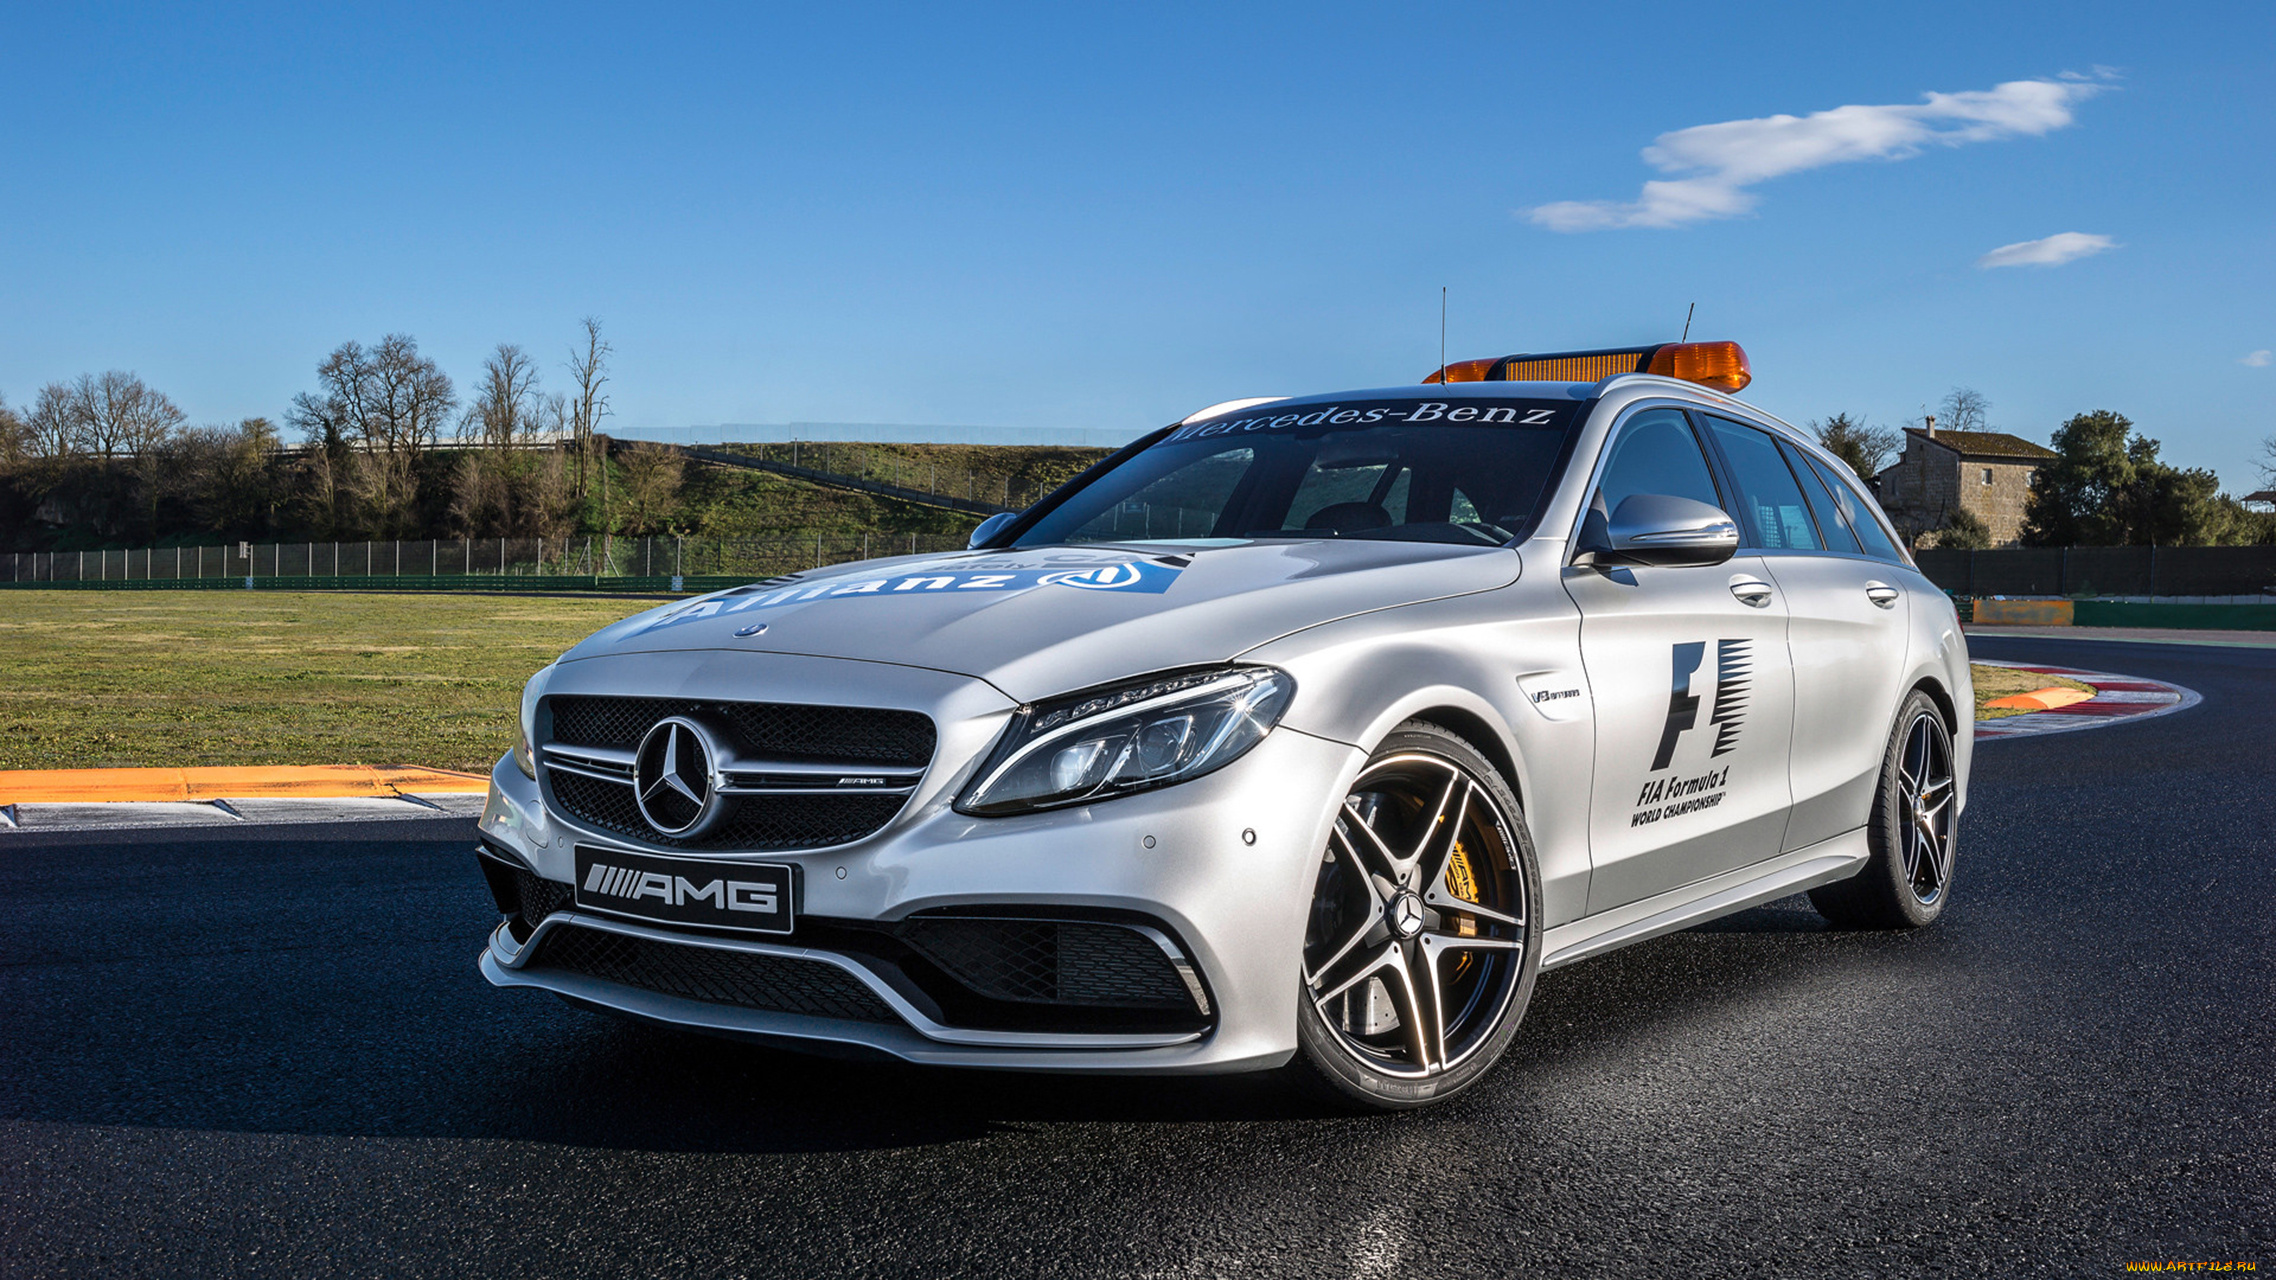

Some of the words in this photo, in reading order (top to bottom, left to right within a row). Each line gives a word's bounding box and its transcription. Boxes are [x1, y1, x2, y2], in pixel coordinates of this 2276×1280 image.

[1161, 402, 1557, 442] Mercedes-Benz
[652, 573, 1017, 628] Allianz
[852, 777, 884, 785] AMG
[1636, 779, 1665, 807] FIA
[1664, 769, 1719, 801] Formula
[1719, 765, 1730, 787] 1
[1630, 807, 1662, 828] WORLD
[632, 871, 778, 915] AMG
